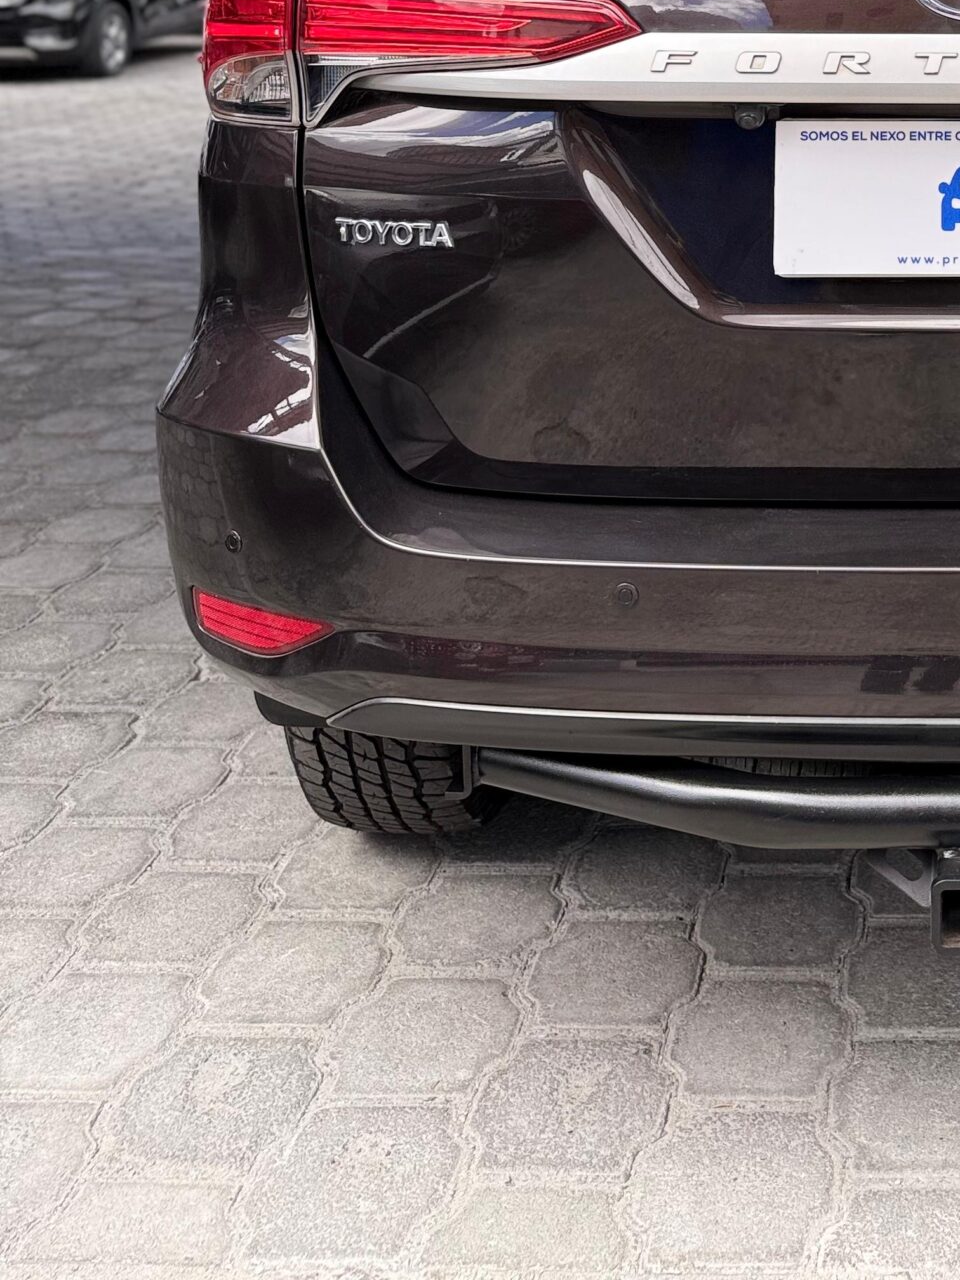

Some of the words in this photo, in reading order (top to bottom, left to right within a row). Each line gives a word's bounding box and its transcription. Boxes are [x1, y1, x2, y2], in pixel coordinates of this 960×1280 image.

[799, 130, 849, 142] SOMOS
[851, 130, 868, 142] EL
[870, 130, 906, 142] NEXO
[909, 130, 953, 142] ENTRE
[335, 217, 453, 248] TOYOTA
